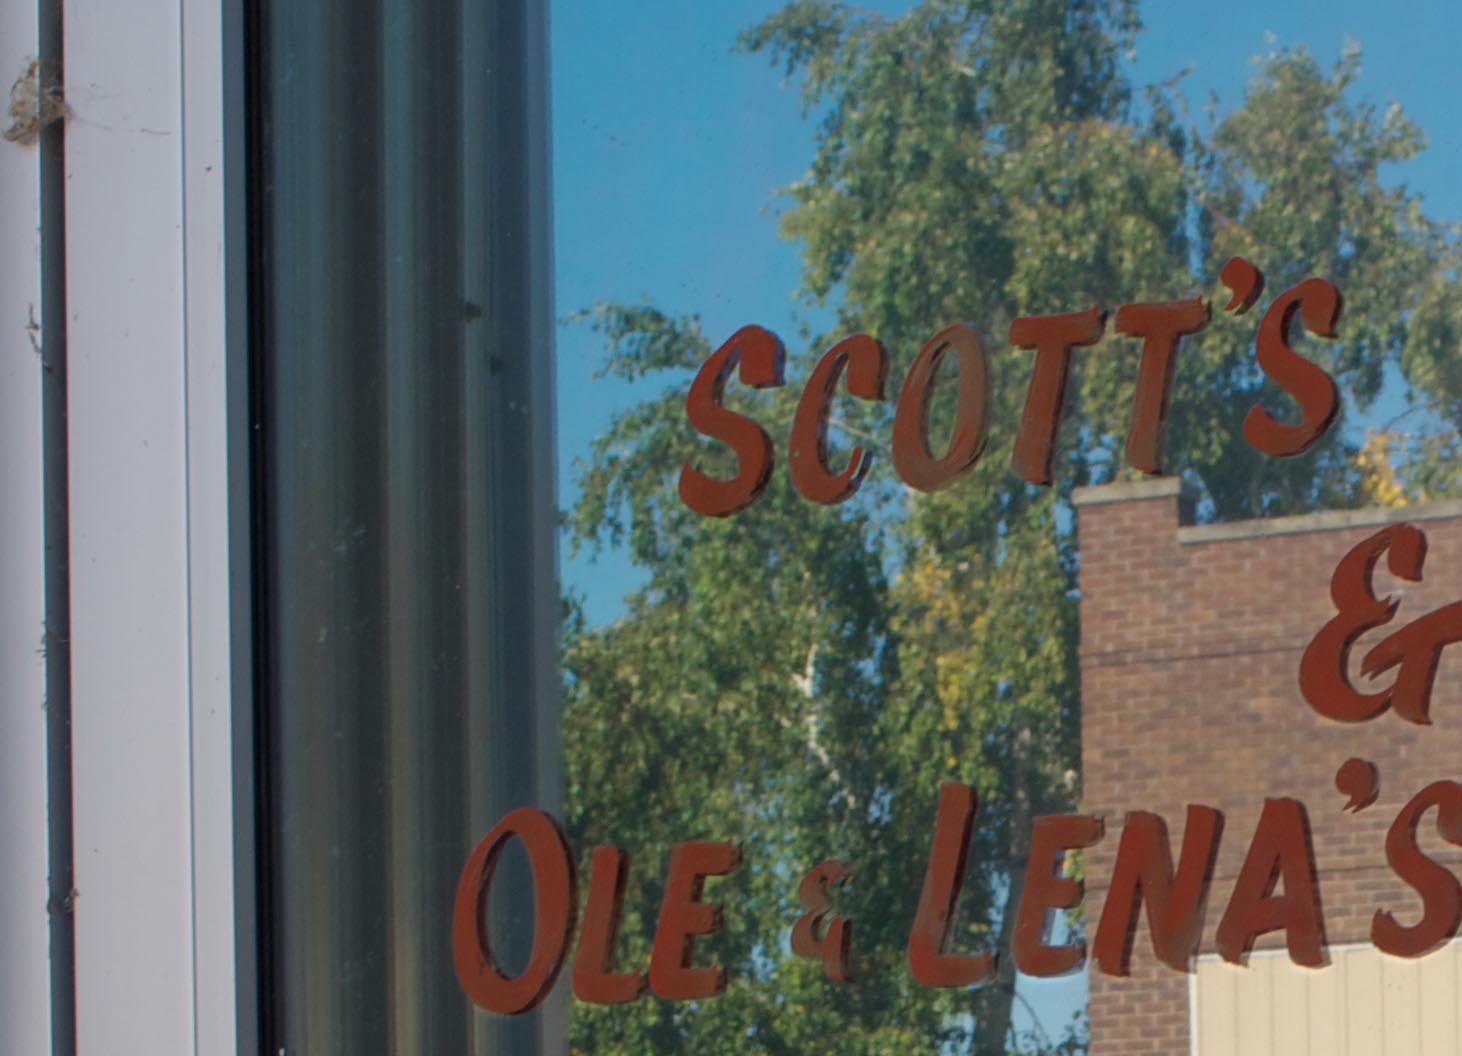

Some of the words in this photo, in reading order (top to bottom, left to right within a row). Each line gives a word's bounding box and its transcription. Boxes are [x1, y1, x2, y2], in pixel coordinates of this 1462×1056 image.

[677, 256, 1342, 516] SCOTT'S
[452, 806, 742, 1015] OLE
[791, 860, 853, 983] &
